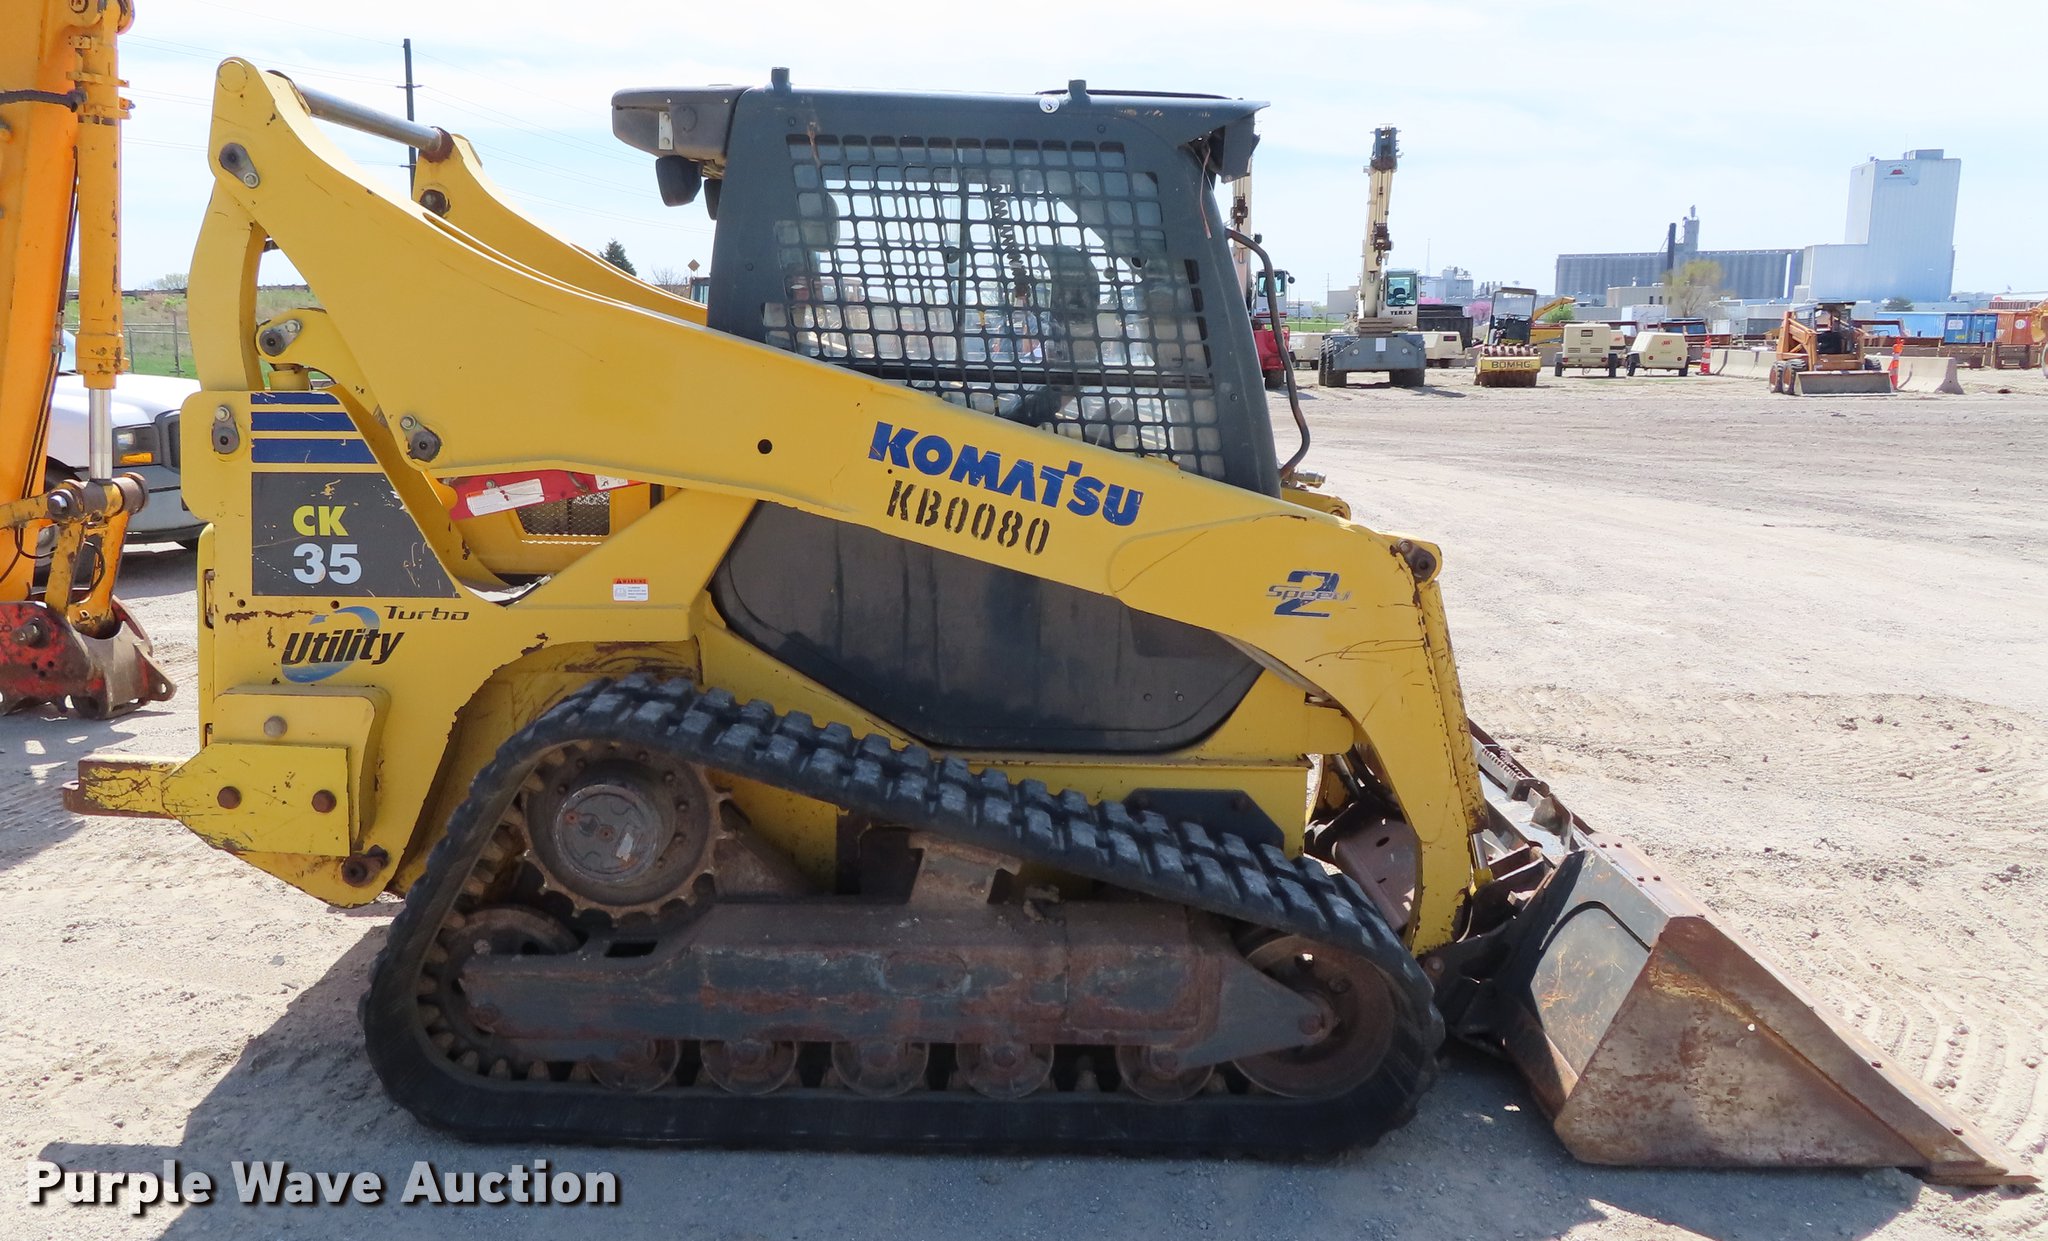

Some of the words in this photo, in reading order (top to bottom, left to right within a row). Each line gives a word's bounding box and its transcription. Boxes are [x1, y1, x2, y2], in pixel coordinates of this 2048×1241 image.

[868, 421, 1144, 526] KOMATSU
[292, 505, 349, 537] CK
[886, 480, 1050, 555] KB0080
[293, 543, 362, 584] 35
[384, 605, 470, 621] Turbo
[1273, 570, 1340, 618] 2
[281, 629, 405, 665] Utility
